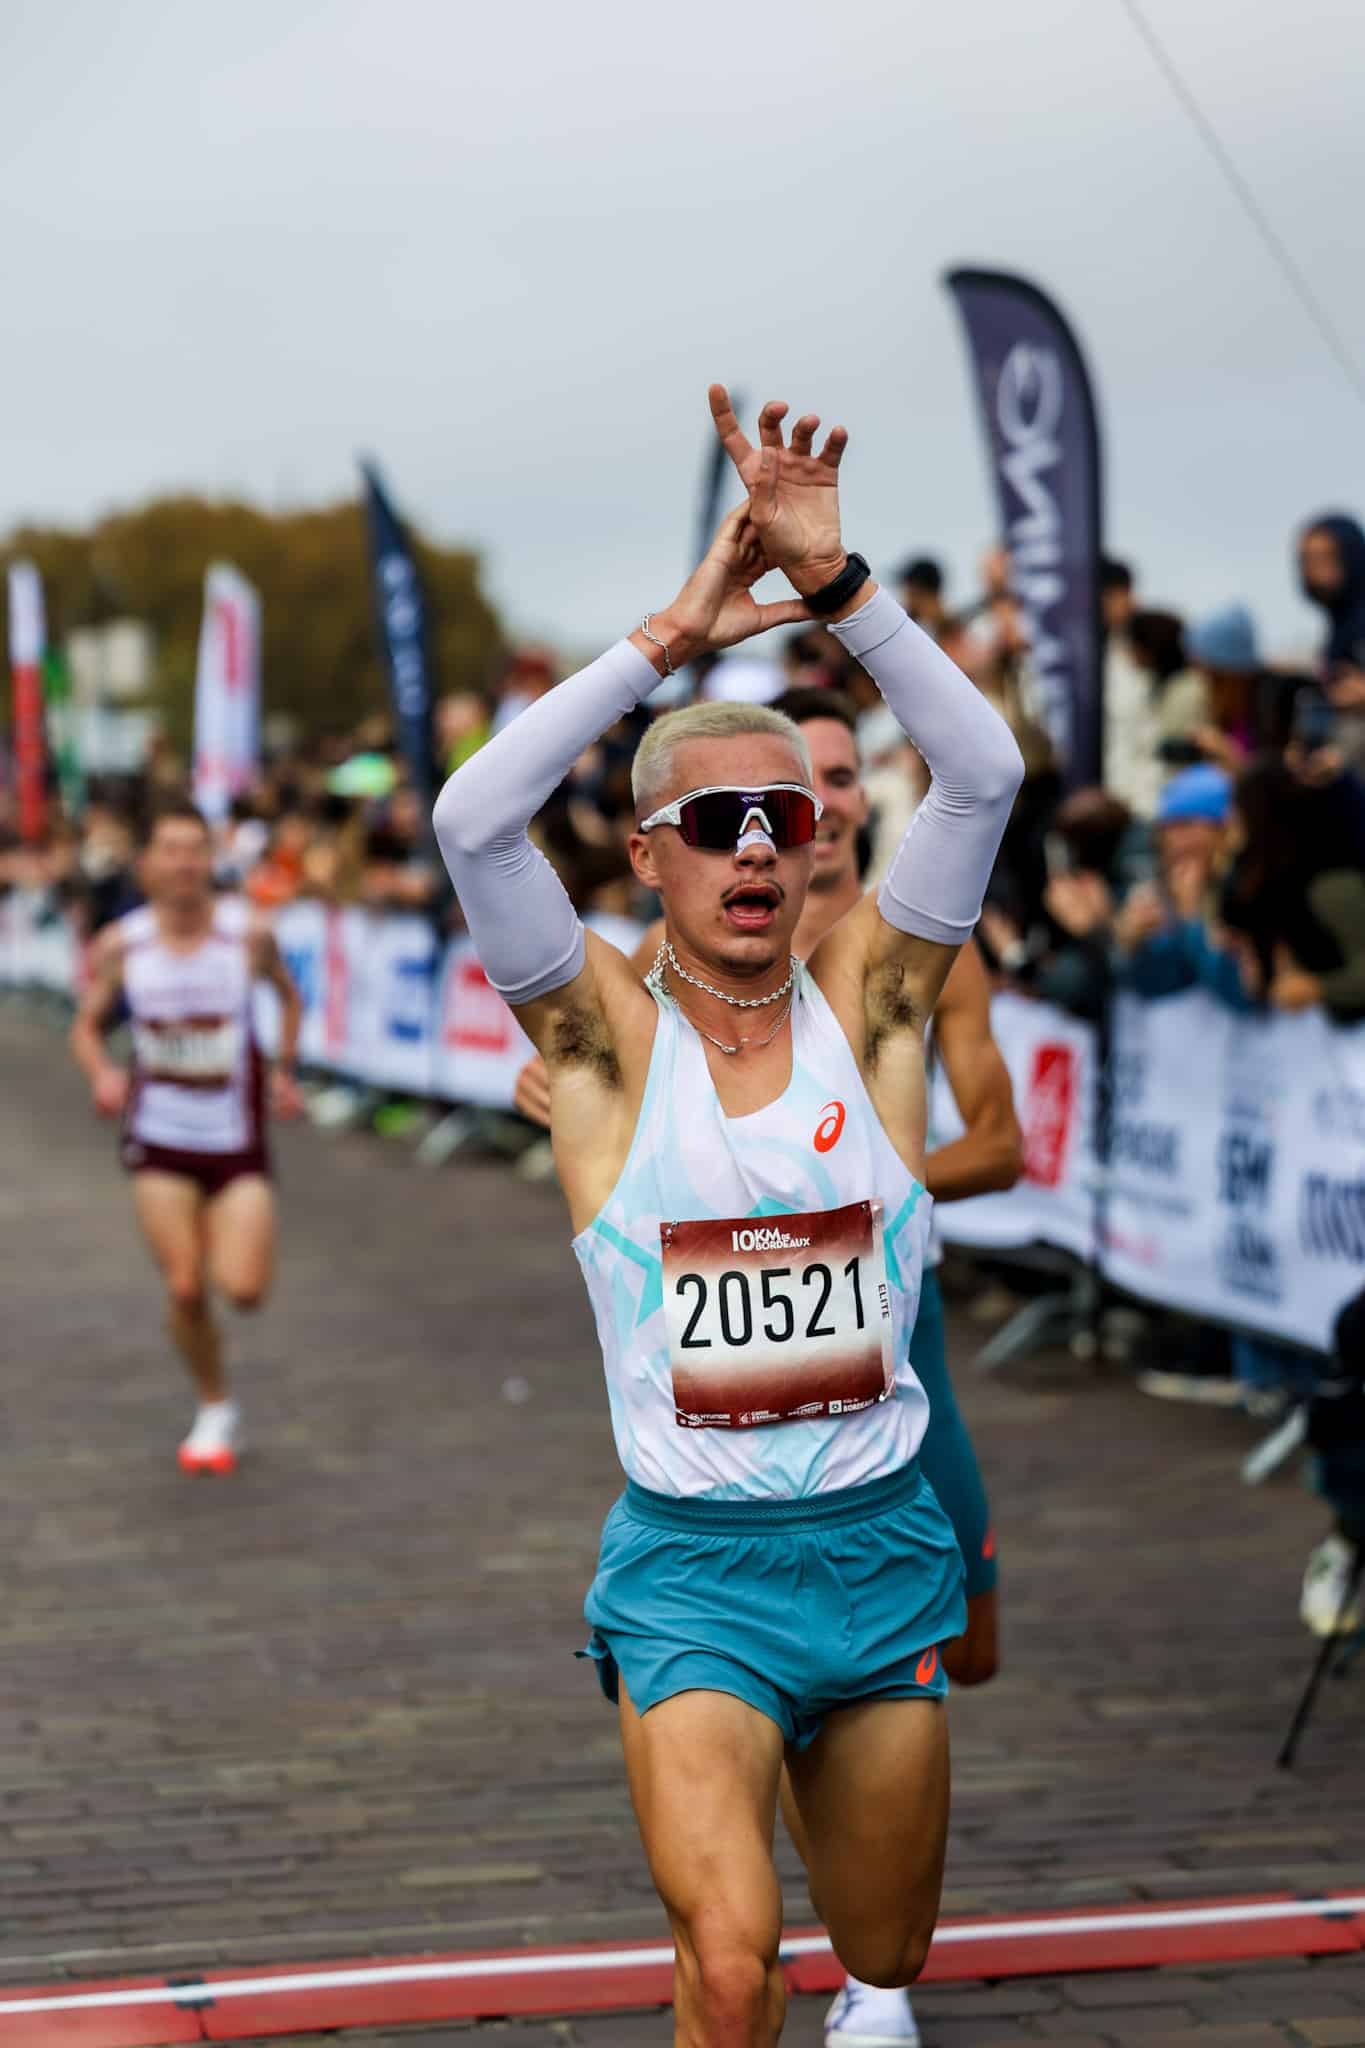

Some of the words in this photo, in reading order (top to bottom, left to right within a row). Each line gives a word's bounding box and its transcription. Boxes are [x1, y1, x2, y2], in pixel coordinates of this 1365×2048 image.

[756, 1237, 810, 1250] BORDEAUX
[676, 1256, 865, 1348] 20521
[878, 1284, 890, 1319] ELITE
